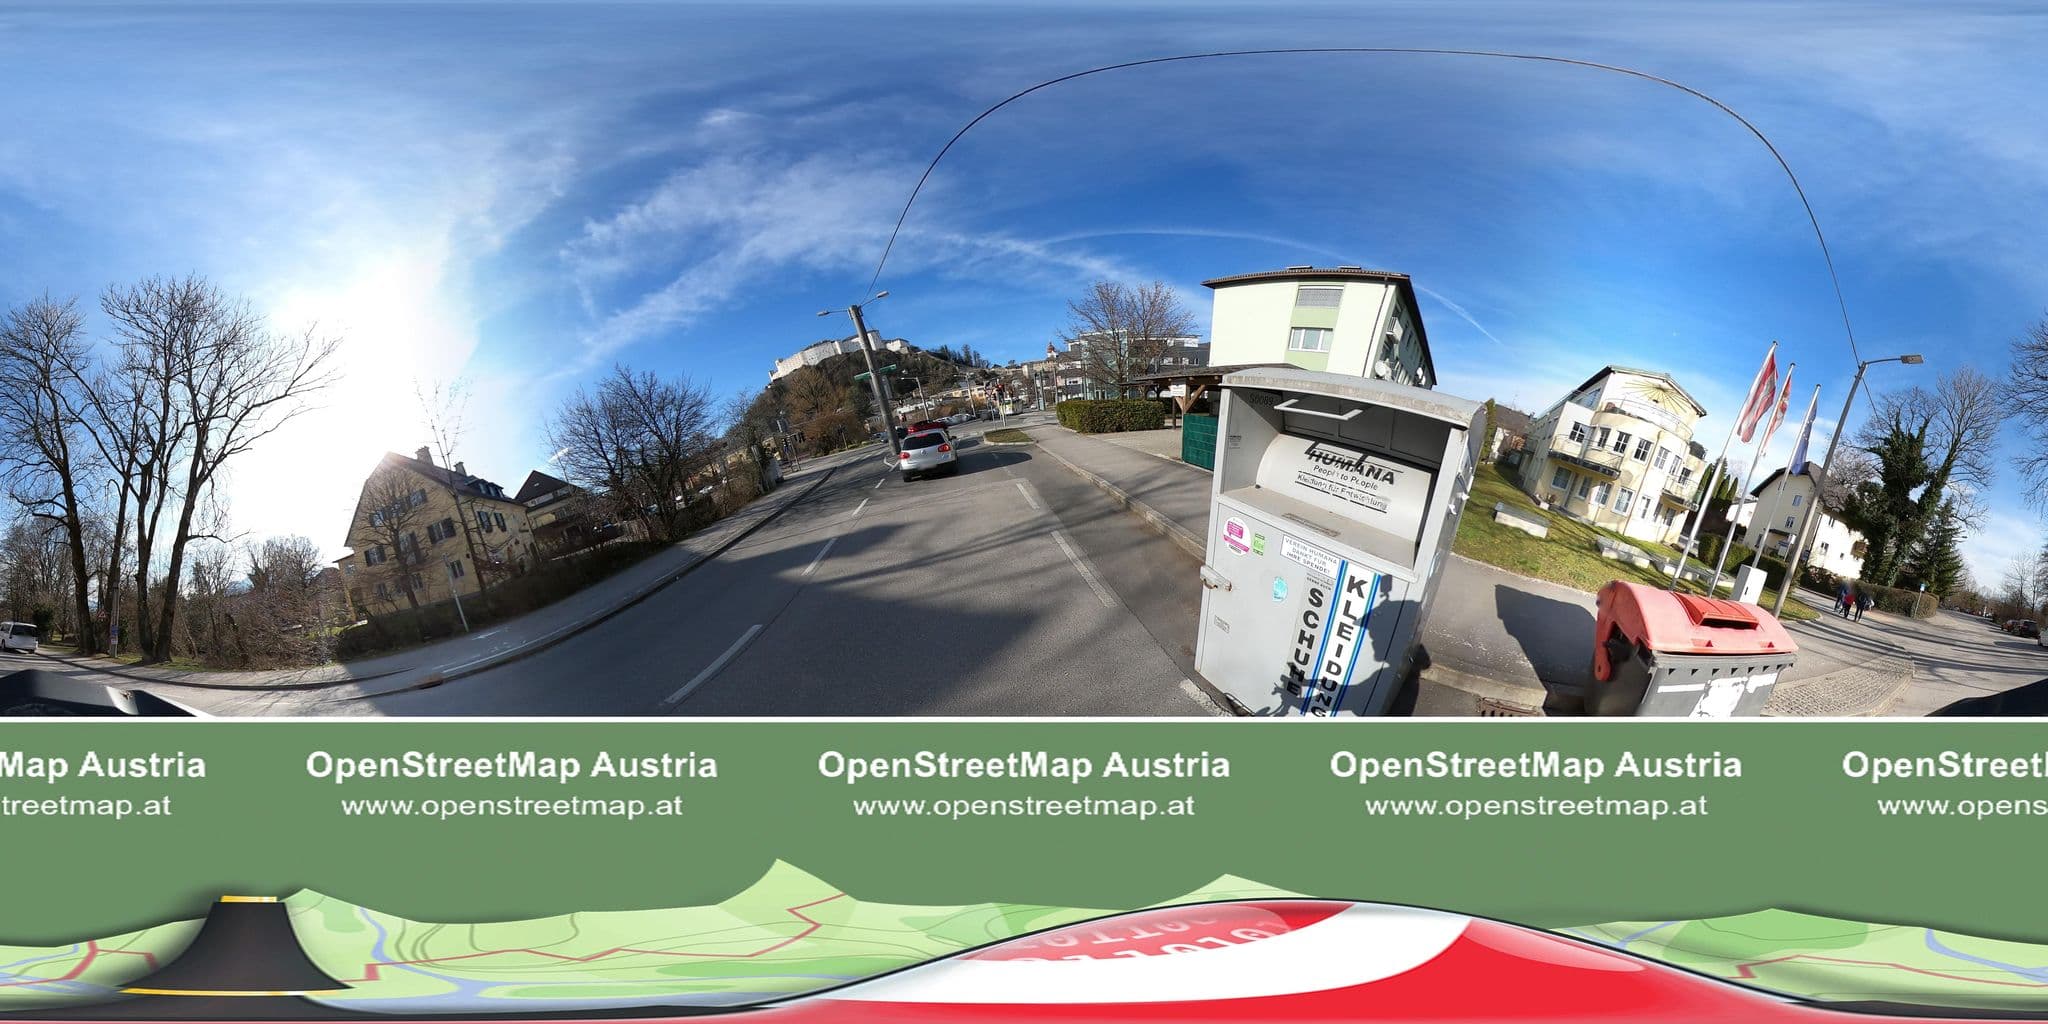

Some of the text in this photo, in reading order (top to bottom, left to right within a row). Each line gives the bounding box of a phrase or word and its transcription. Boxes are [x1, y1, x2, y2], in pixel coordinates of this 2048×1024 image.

[1307, 448, 1396, 485] HUMANA
[1340, 473, 1349, 482] to
[1309, 548, 1337, 564] HUMANA
[1286, 588, 1324, 696] SCHUHE
[1311, 575, 1368, 717] KLEIDUNG
